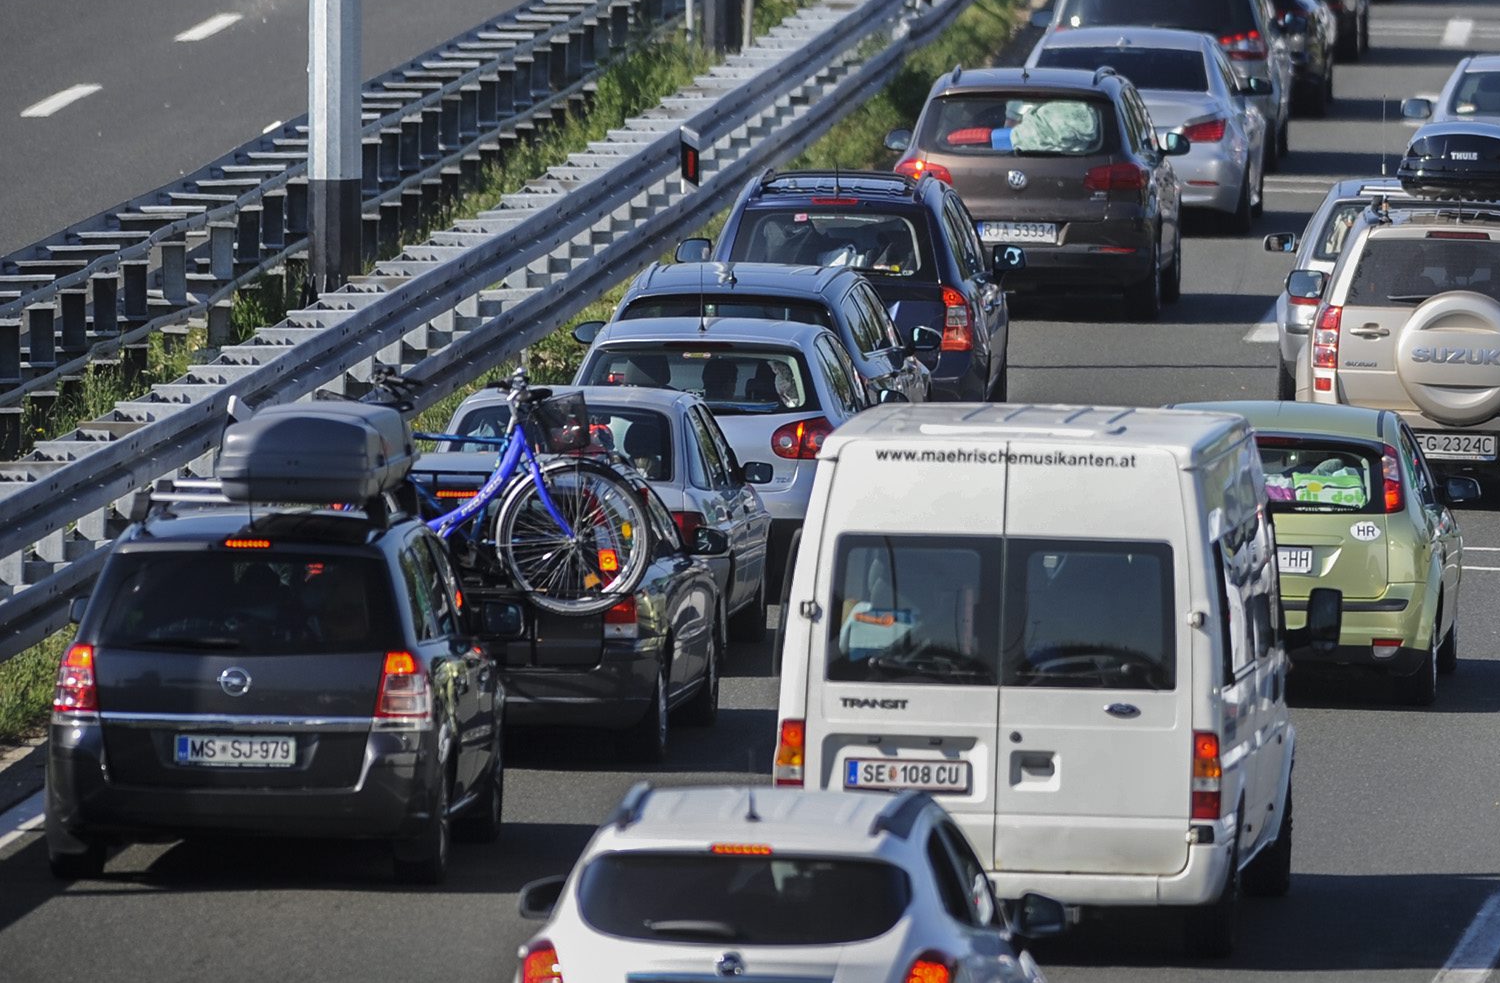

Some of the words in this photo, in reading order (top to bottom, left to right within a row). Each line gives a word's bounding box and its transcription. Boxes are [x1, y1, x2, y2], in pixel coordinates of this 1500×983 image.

[1450, 152, 1478, 160] THULE
[984, 223, 1010, 237] RJA
[1442, 436, 1493, 453] 2324C
[875, 448, 1137, 468] www.maehrischemusikanten.at
[1356, 525, 1376, 537] HR
[840, 698, 909, 710] TRANSIT
[191, 740, 217, 758] MS
[230, 740, 290, 759] SJ-979
[863, 764, 886, 783] SE
[901, 765, 931, 784] 108
[936, 765, 960, 785] CU
